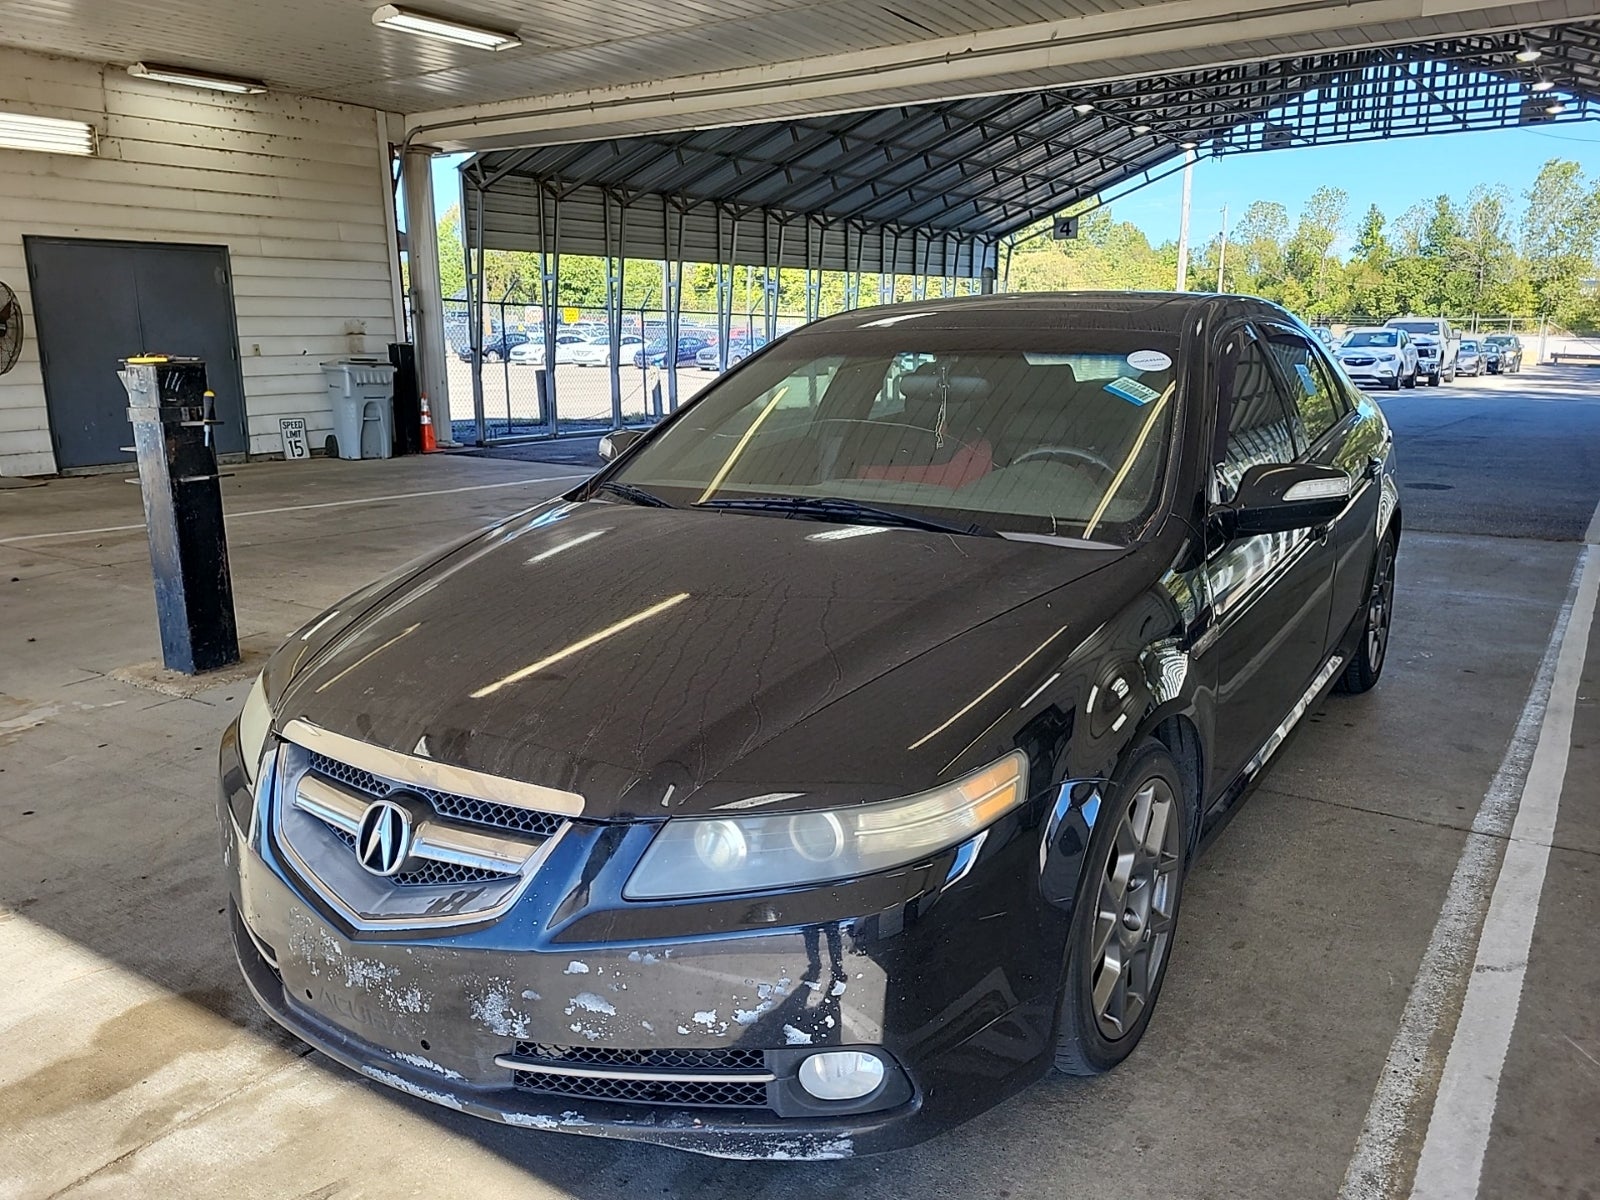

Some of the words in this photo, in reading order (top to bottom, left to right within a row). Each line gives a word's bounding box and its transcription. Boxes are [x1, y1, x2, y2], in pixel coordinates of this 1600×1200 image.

[1060, 221, 1072, 236] 4
[282, 421, 303, 429] SPEED
[286, 430, 301, 438] LIMIT
[288, 440, 304, 457] 15
